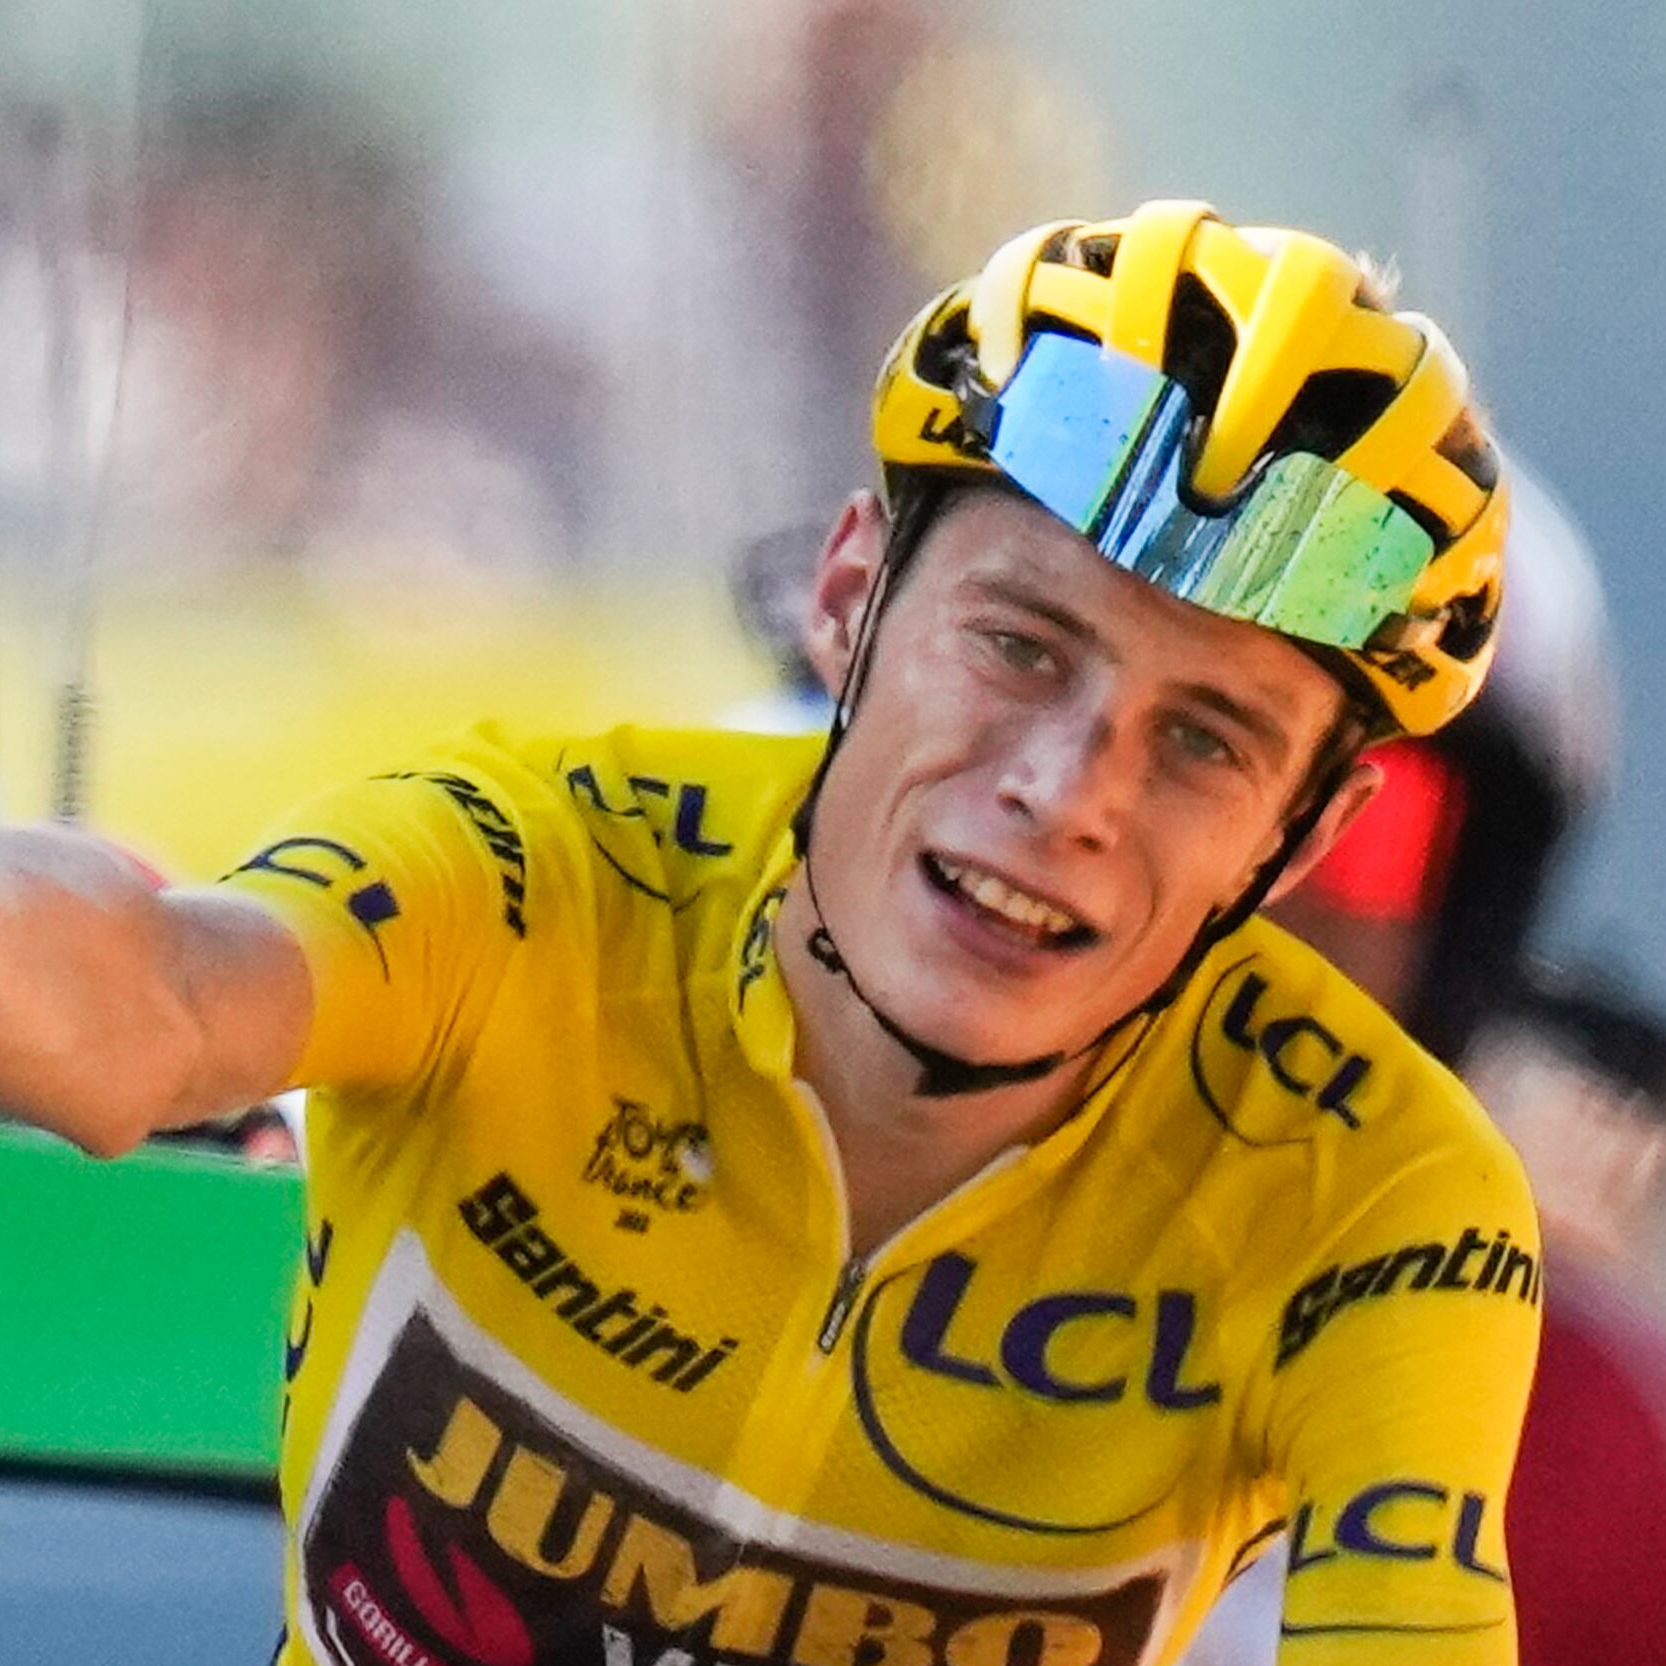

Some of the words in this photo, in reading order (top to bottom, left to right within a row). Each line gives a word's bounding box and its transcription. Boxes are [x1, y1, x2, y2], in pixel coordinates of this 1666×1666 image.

[1223, 972, 1373, 1130] LCL
[459, 1171, 738, 1393] Santini
[898, 1250, 1223, 1412] LCL
[1288, 1480, 1505, 1583] LCL
